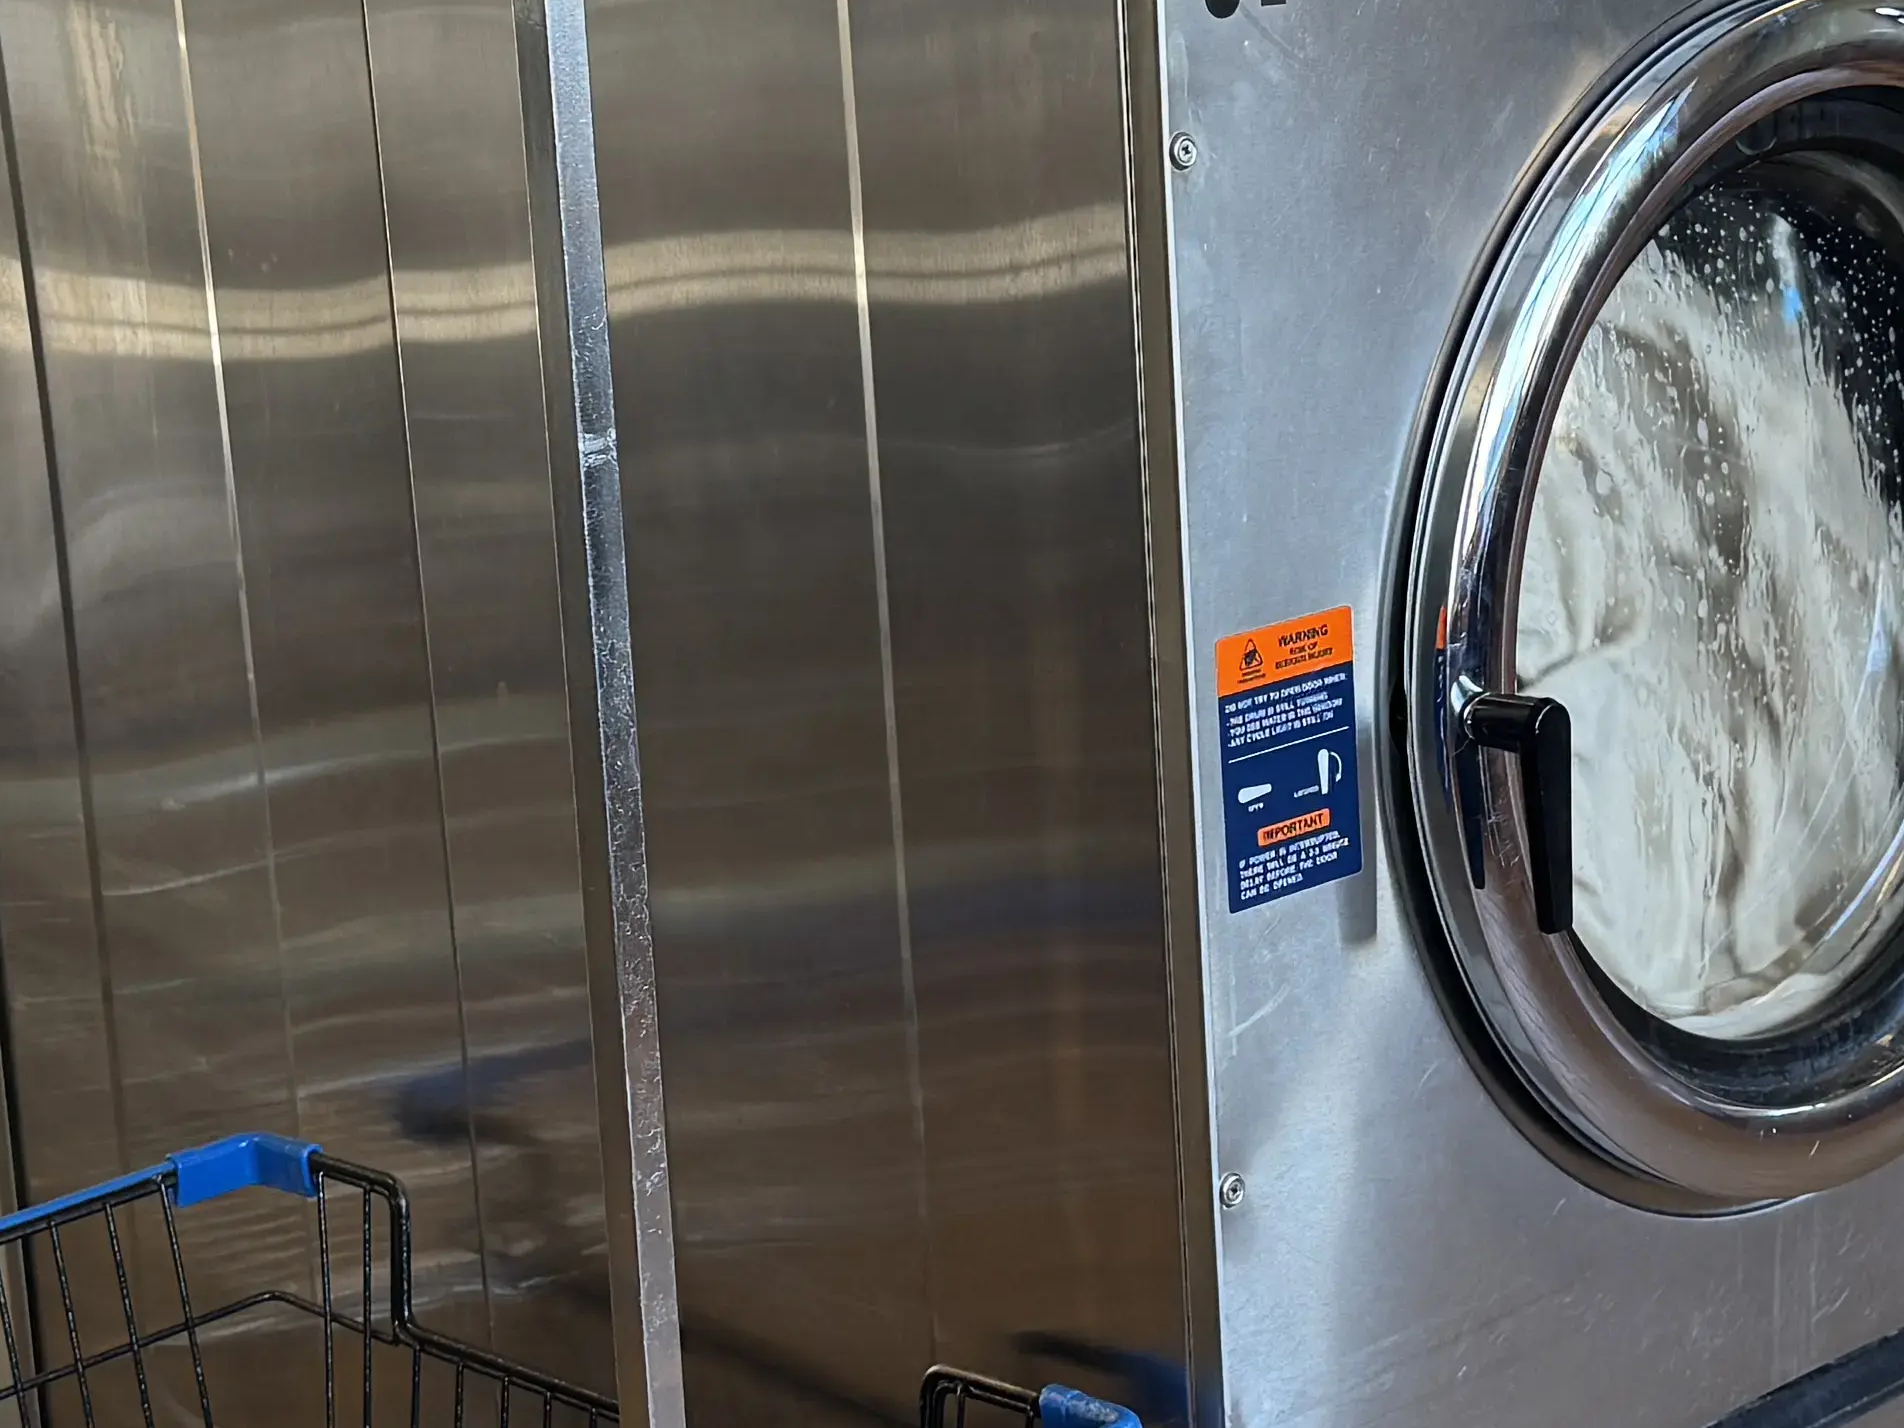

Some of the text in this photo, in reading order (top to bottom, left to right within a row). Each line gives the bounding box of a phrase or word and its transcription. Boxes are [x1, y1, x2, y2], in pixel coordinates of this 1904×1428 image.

[1278, 624, 1328, 647] WARNING
[1281, 684, 1301, 698] OPEN
[1302, 678, 1323, 692] DOOR
[1262, 812, 1323, 841] IMPORTANT
[1249, 850, 1275, 864] POWER
[1240, 865, 1263, 879] THERE
[1241, 875, 1264, 890] DELAY
[1266, 865, 1296, 881] BEFORE
[1316, 851, 1338, 865] DOOR
[1273, 873, 1303, 890] OPENED
